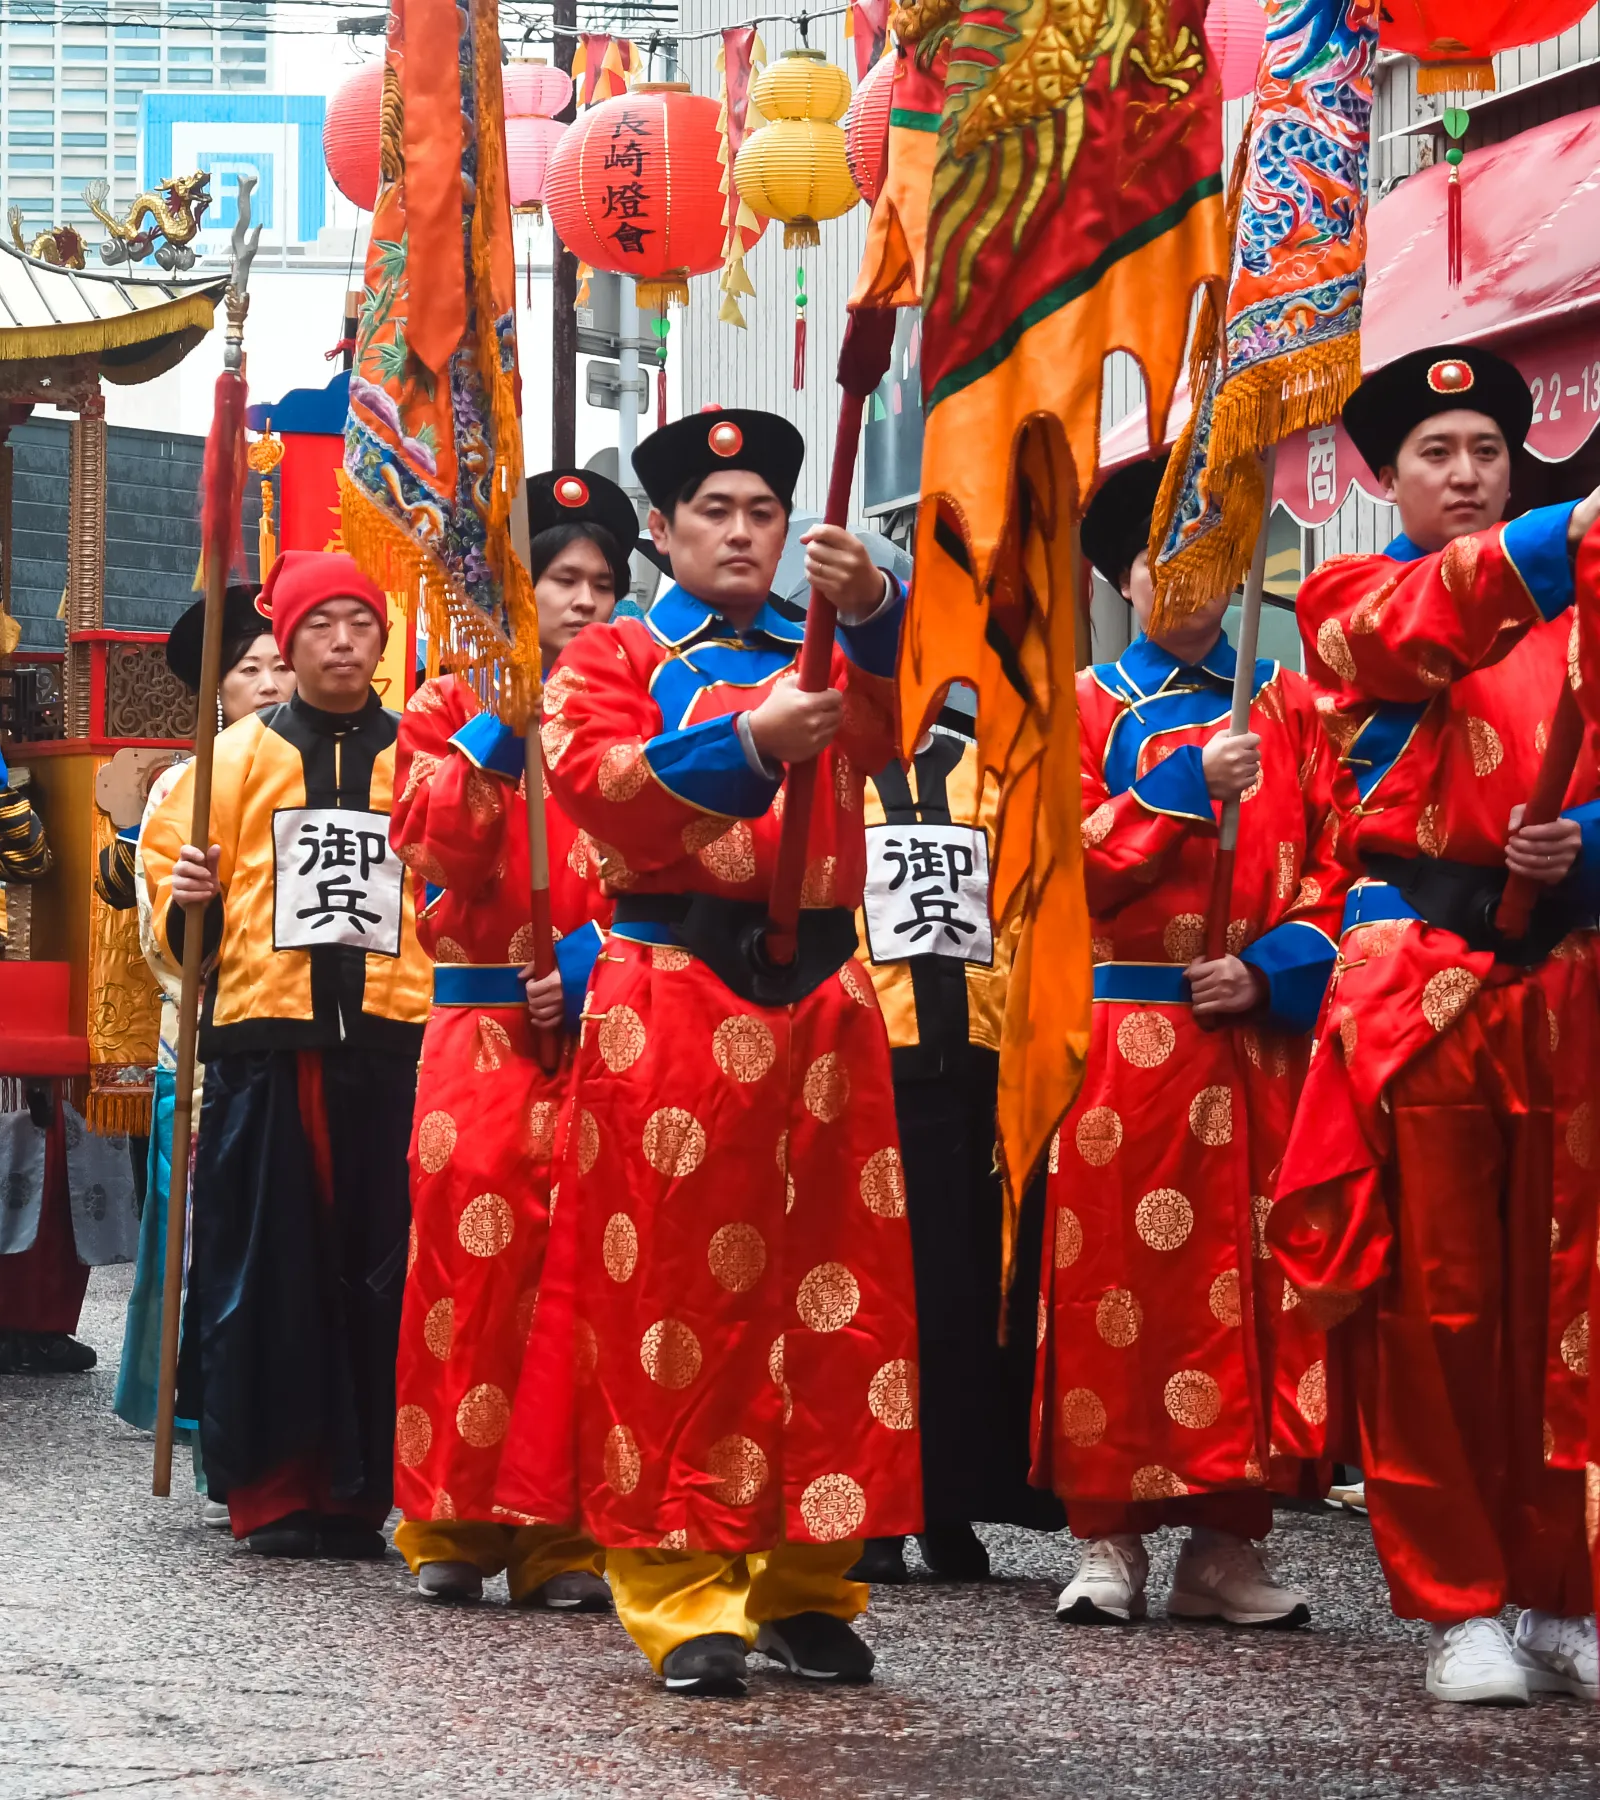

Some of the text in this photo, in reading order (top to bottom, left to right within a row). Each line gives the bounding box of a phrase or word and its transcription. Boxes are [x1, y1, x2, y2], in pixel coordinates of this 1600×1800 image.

[601, 111, 656, 254] 長崎燈會
[1530, 361, 1600, 424] 22-13
[1307, 422, 1337, 510] 商
[296, 823, 386, 934] 御兵
[883, 838, 977, 945] 御兵
